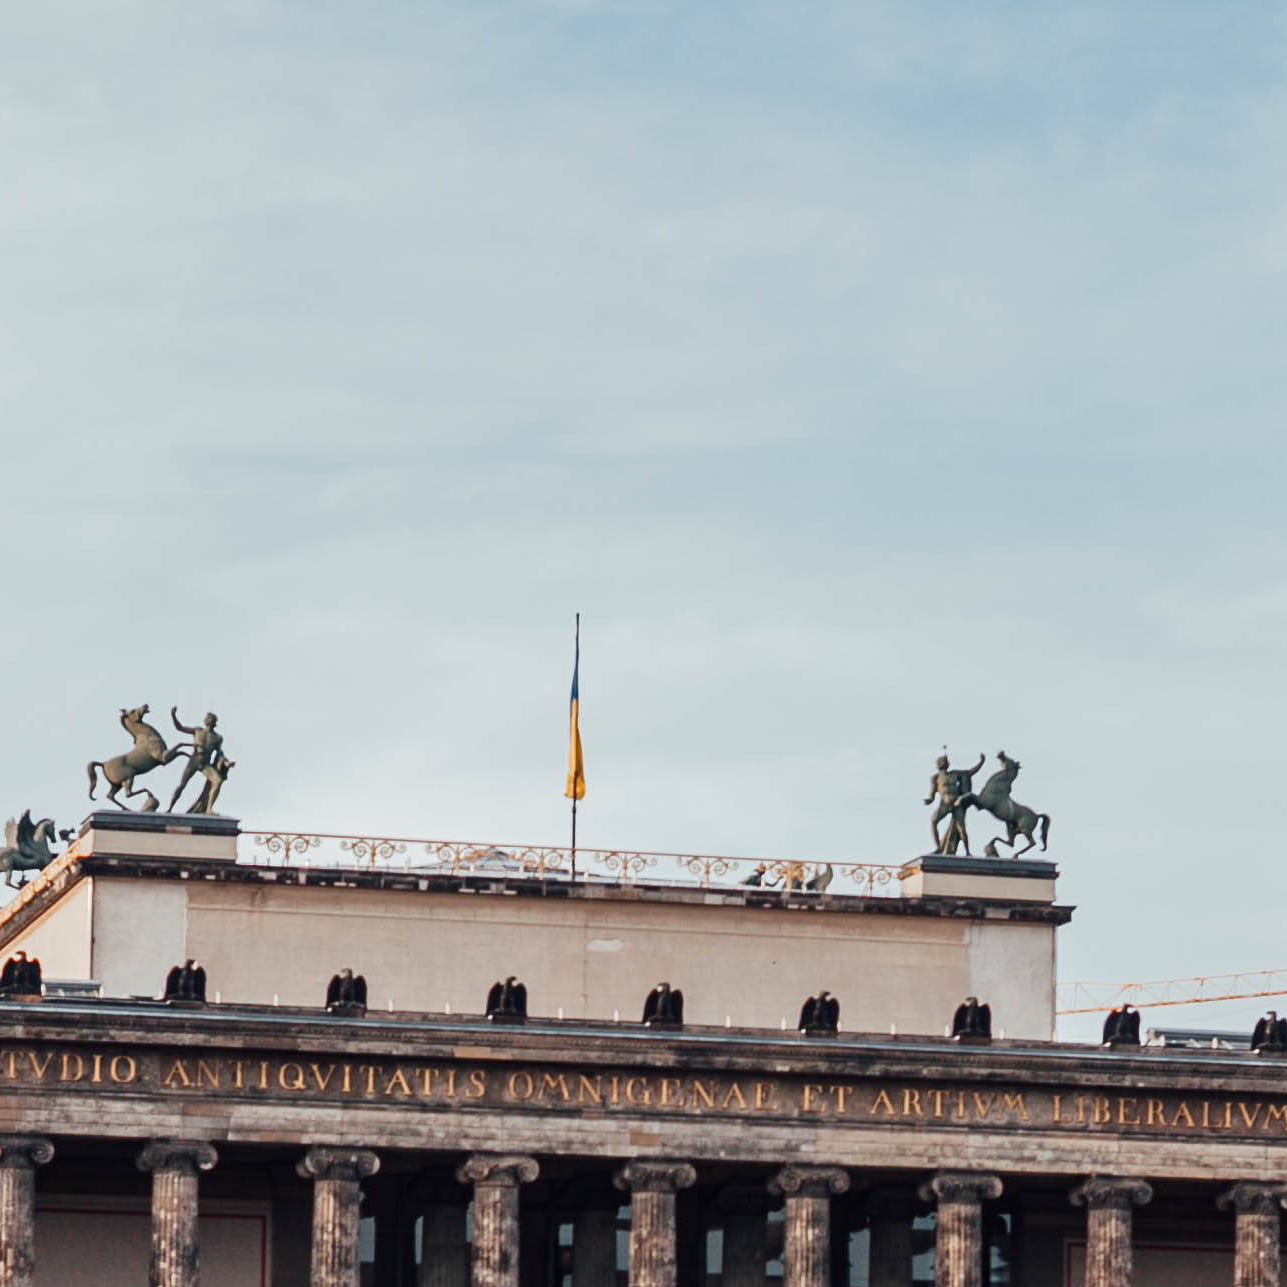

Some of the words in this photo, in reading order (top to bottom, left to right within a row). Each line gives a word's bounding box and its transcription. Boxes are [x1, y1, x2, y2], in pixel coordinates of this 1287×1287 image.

[164, 1058, 486, 1099] ANTIQVITATIS
[507, 1071, 778, 1112] OMNIGENAE
[802, 1084, 853, 1114] ET
[869, 1089, 1030, 1122] ARTIVM
